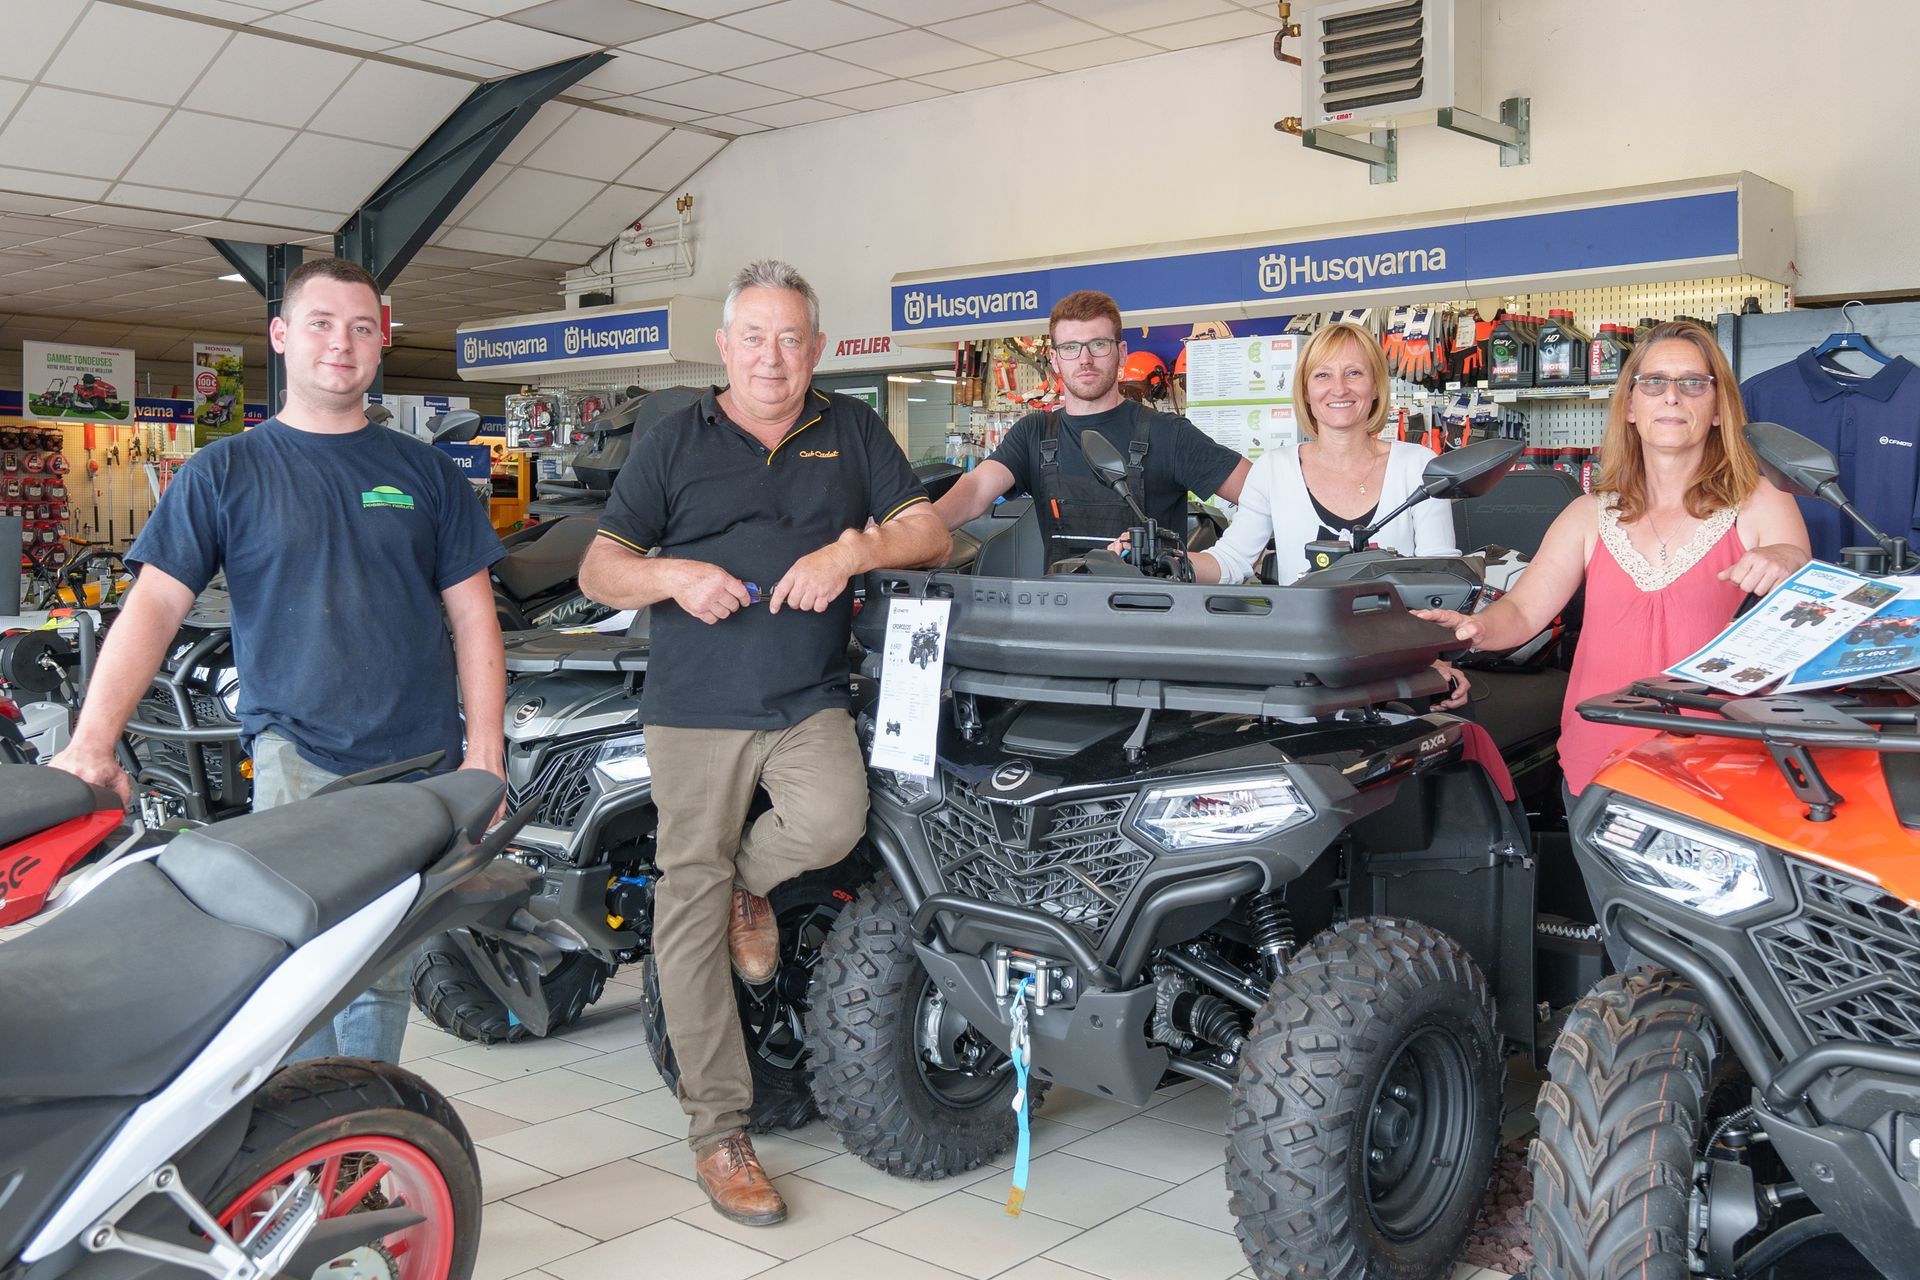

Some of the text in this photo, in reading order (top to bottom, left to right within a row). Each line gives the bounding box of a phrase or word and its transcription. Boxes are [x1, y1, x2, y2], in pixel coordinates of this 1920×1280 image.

[1290, 247, 1447, 284] Husqvarna
[927, 289, 1038, 319] Husqvarna
[580, 325, 659, 350] Husqvarna
[1544, 334, 1560, 343] HD
[478, 337, 548, 360] Husqvarna
[835, 336, 891, 356] ATELIER
[47, 353, 113, 367] GAMME TONDEUSES
[1542, 362, 1568, 371] MOTUL
[1492, 366, 1518, 375] MOTUL
[134, 406, 174, 418] varna
[814, 450, 839, 458] Cadet
[974, 589, 1068, 606] CFMOTO
[1821, 667, 1863, 676] CFORCE
[1421, 733, 1447, 752] 4X4
[832, 889, 853, 902] CST
